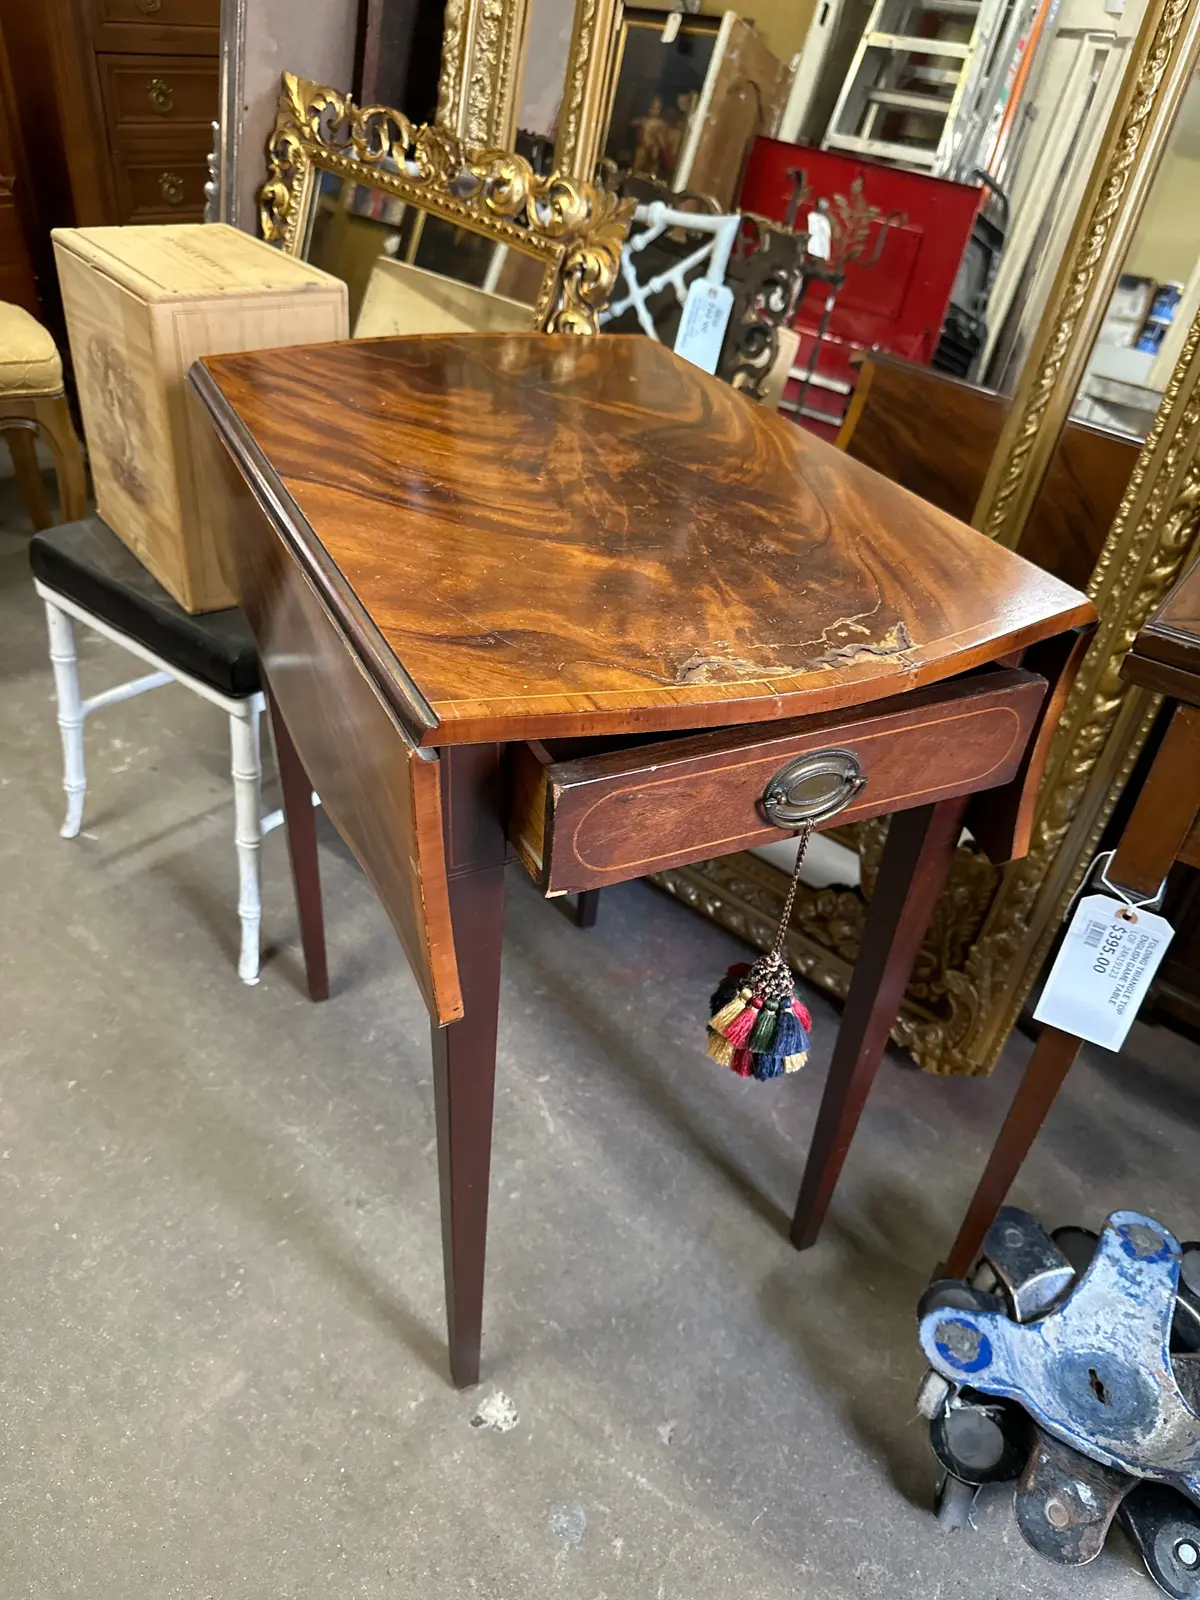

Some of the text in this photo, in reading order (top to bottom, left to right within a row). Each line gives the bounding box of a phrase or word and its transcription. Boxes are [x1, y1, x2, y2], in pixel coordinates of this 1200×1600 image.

[1092, 924, 1127, 974] $395.00
[1108, 944, 1131, 978] 24K19123
[1108, 934, 1148, 1006] ENGLISH GAME TABLE
[1116, 937, 1159, 1016] FOLDING TRIANGLE TOP
